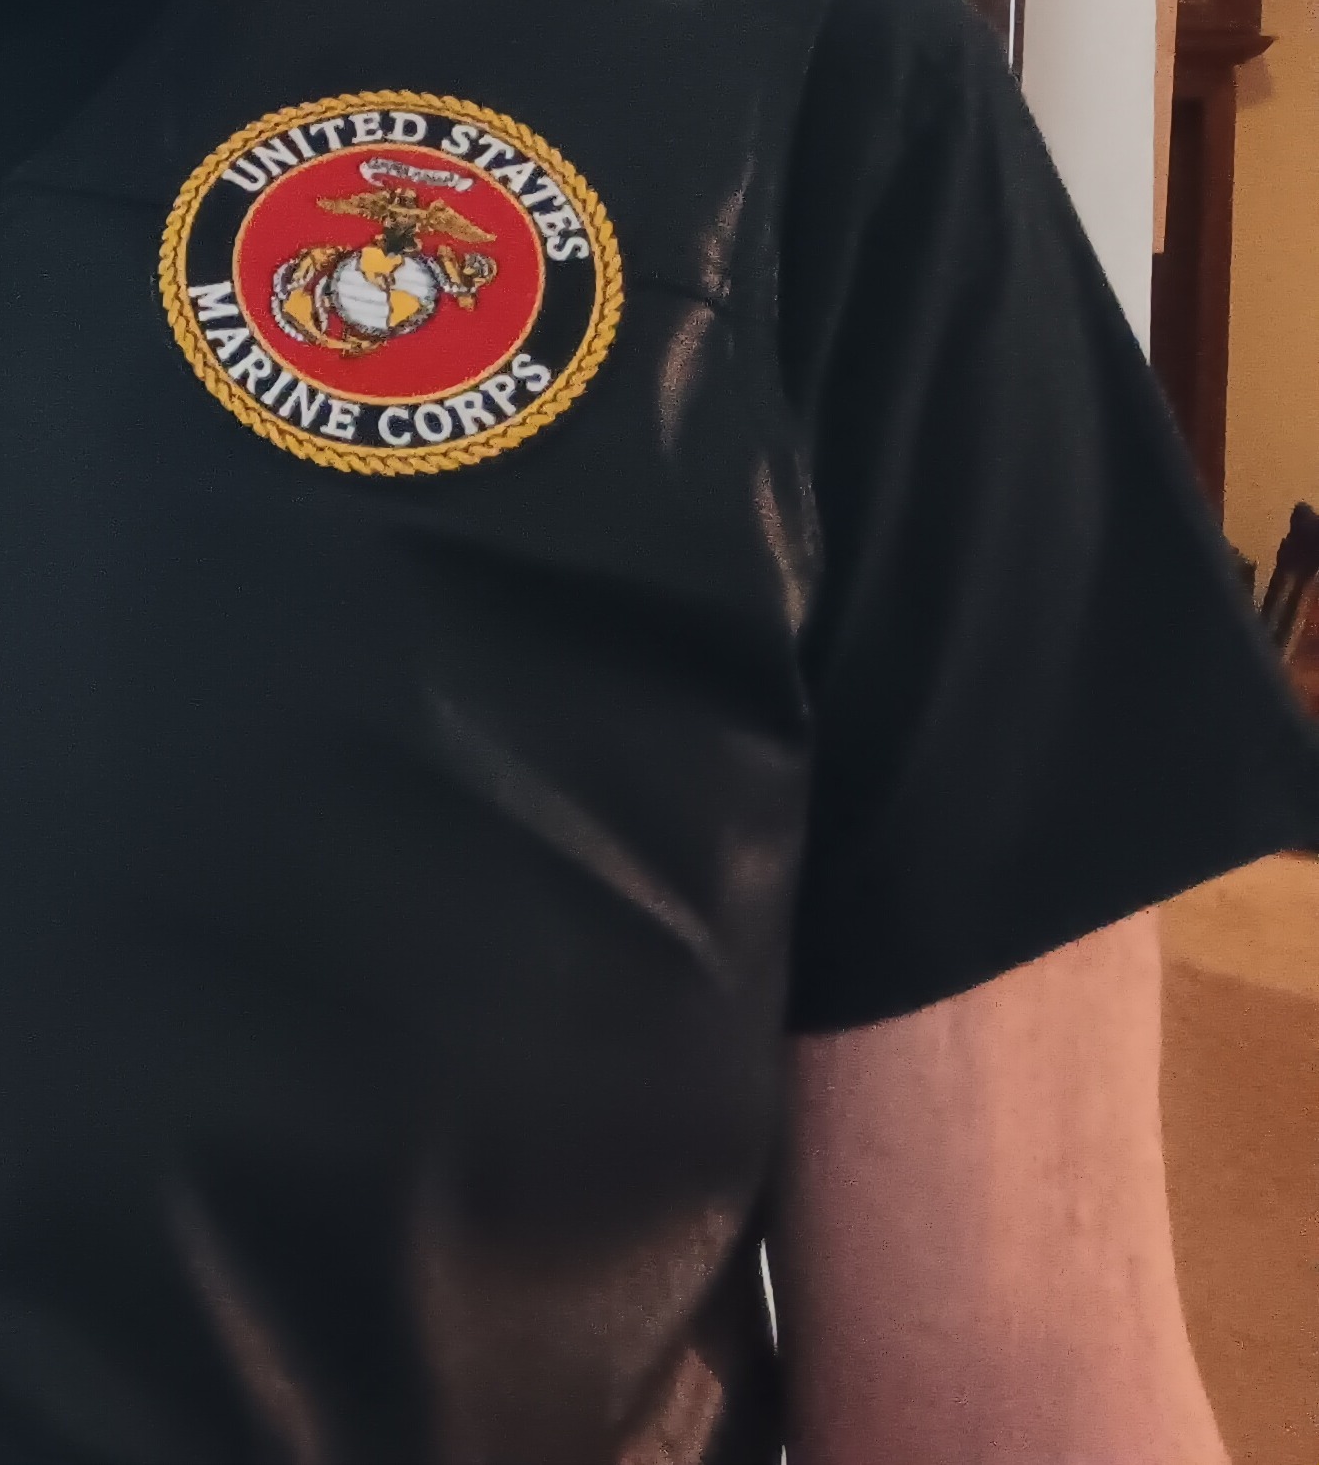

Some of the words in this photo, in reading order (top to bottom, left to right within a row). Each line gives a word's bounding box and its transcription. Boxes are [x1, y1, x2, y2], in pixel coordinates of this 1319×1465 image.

[222, 111, 428, 193] UNITED
[440, 123, 590, 262] STATES
[188, 280, 361, 442] MARINE
[377, 353, 552, 447] CORPS
